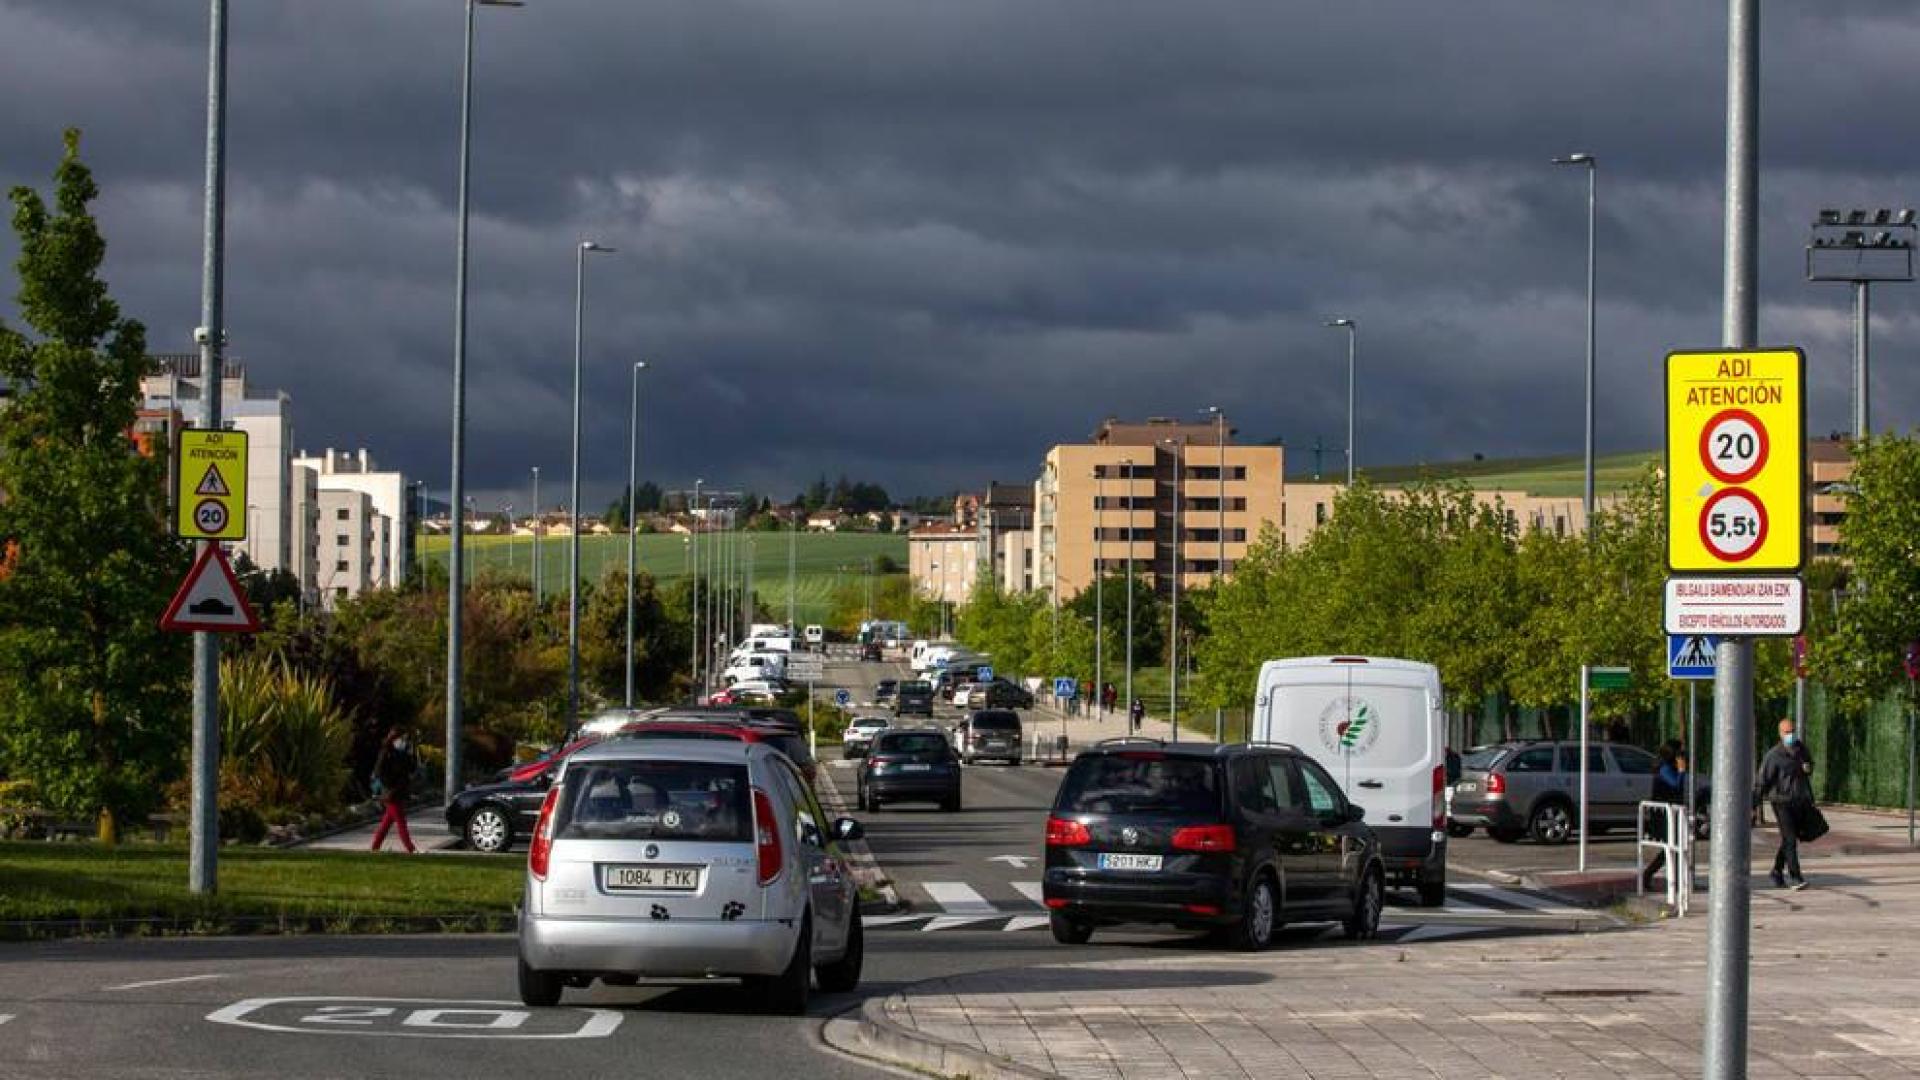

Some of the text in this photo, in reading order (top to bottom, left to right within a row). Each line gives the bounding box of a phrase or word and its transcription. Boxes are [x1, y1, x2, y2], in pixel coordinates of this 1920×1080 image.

[1717, 358, 1751, 378] ADI
[1686, 381, 1782, 406] ATENCIÓN
[1717, 433, 1754, 460] 20
[201, 509, 222, 524] 20
[619, 870, 690, 885] 1084 FYK
[300, 1007, 531, 1028] 20
